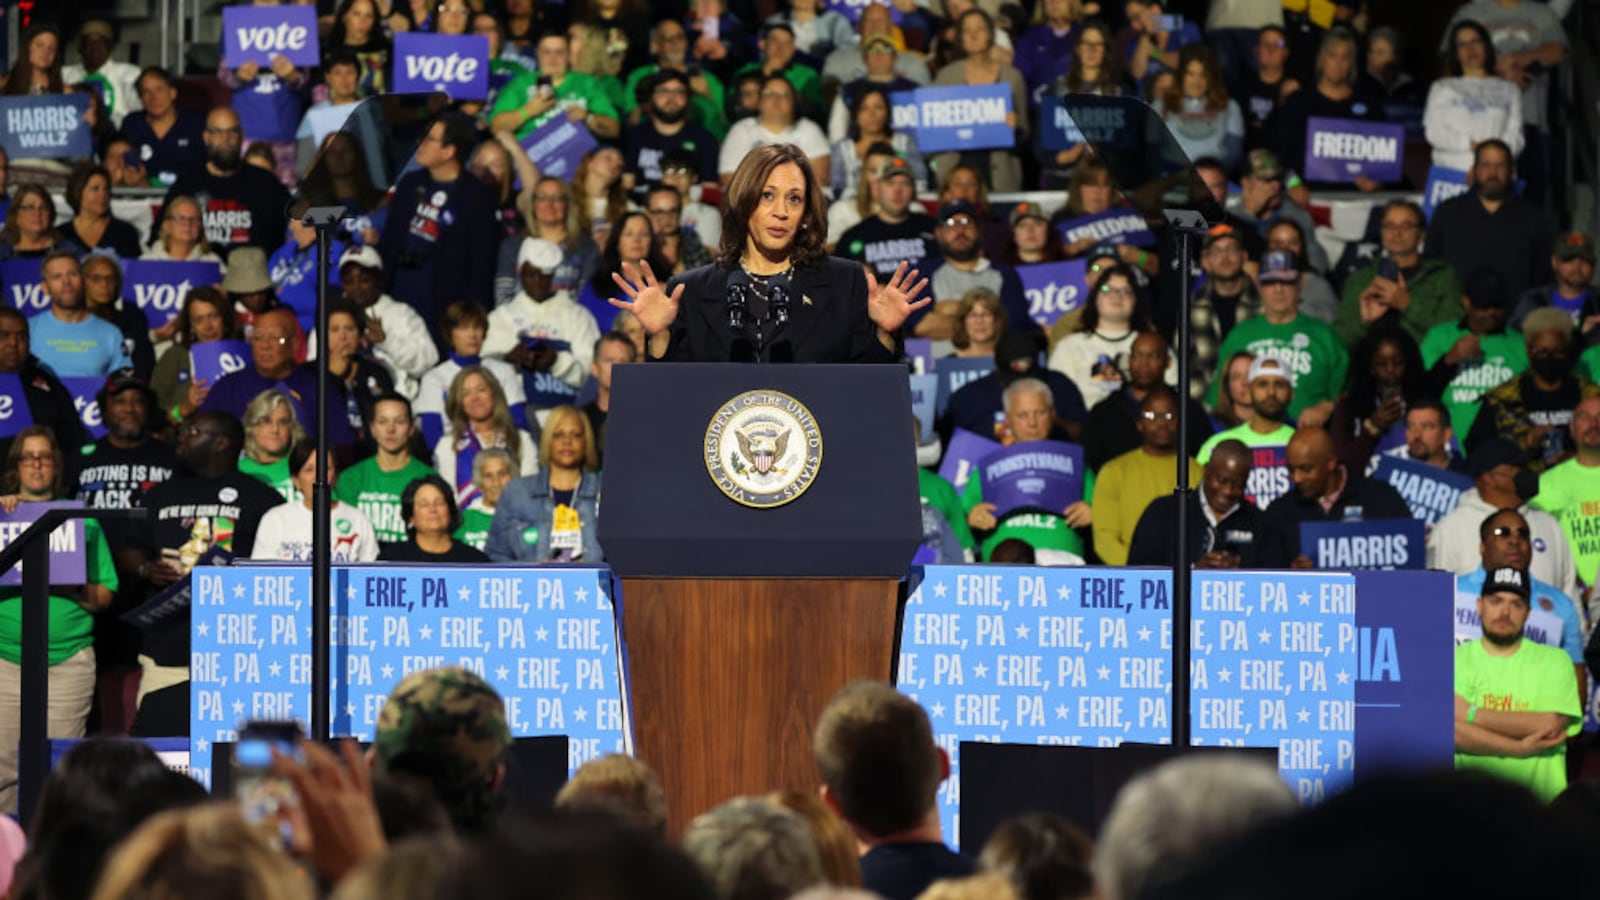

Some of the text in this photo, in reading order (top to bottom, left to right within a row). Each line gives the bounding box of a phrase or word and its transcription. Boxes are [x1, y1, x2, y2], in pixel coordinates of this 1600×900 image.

[237, 22, 307, 50] vote
[405, 51, 478, 83] vote
[7, 105, 78, 133] HARRIS
[922, 97, 1007, 128] FREEDOM
[1054, 105, 1126, 129] HARRIS
[19, 131, 68, 147] WALZ
[1313, 131, 1397, 163] FREEDOM
[707, 395, 819, 500] VICE PRESIDENT OF THE UNITED STATES
[132, 465, 148, 482] IS
[180, 505, 196, 518] NOT
[1318, 534, 1408, 568] HARRIS
[1494, 567, 1522, 586] USA
[199, 575, 225, 605] PA
[253, 575, 302, 611] ERIE,
[365, 576, 415, 612] ERIE,
[421, 577, 449, 608] PA
[479, 577, 530, 614] ERIE,
[537, 578, 565, 610] PA
[956, 574, 1010, 612] ERIE,
[1018, 575, 1048, 607] PA
[1080, 577, 1133, 614] ERIE,
[1140, 579, 1169, 610] PA
[1201, 580, 1254, 616] ERIE,
[1260, 582, 1289, 613] PA
[1319, 583, 1356, 614] ERI
[217, 614, 264, 650] ERIE,
[271, 614, 298, 645] PA
[383, 616, 410, 647] PA
[440, 617, 491, 653] ERIE,
[498, 618, 526, 649] PA
[557, 618, 609, 655] ERIE,
[914, 613, 1355, 657] ERIE, PA ERIE, PA EIE, PA ERIE, P
[234, 653, 261, 684] PA
[346, 655, 373, 686] PA
[518, 658, 569, 694] ERIE,
[576, 659, 604, 690] PA
[934, 654, 964, 685] PA
[997, 655, 1050, 691] ERIE,
[1058, 656, 1087, 688] PA
[1119, 657, 1172, 694] ERIE,
[1240, 660, 1292, 696] ERIE,
[1299, 661, 1327, 692] PA
[198, 690, 224, 721] PA
[536, 698, 565, 729] PA
[954, 694, 1355, 735] ERIE, PA ERIE, PA ERIE, PA ERI
[1278, 738, 1330, 775] ERIE,
[1337, 740, 1355, 771] P
